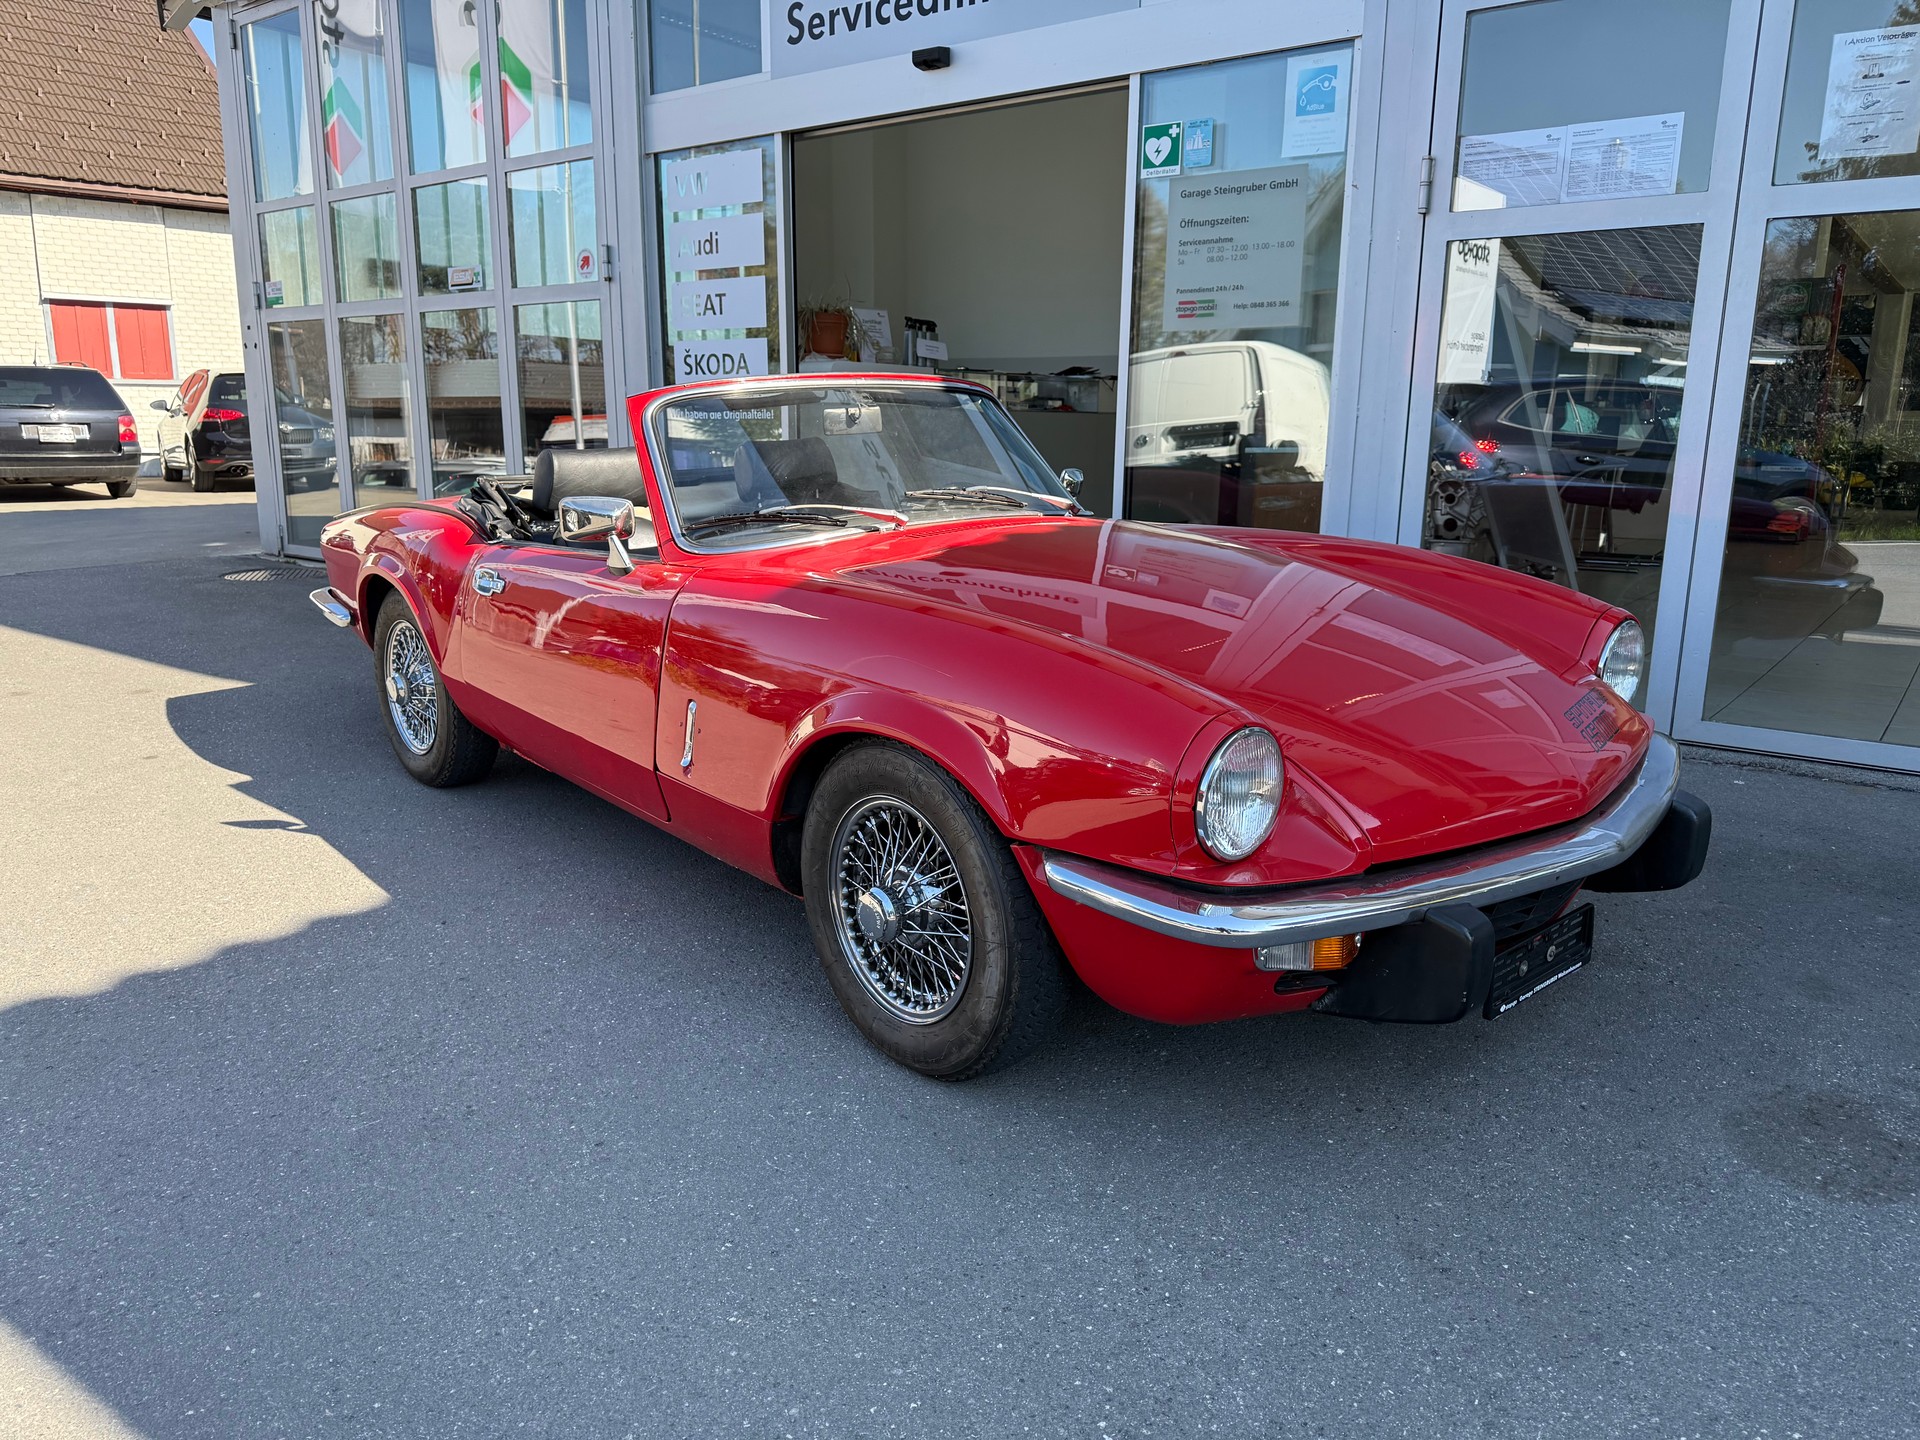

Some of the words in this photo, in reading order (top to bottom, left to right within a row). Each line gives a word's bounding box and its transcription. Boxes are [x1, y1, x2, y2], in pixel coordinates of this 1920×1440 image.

[787, 0, 990, 45] Servicea
[1848, 36, 1875, 46] Aktion
[1146, 168, 1177, 176] Defibrillator
[675, 171, 708, 198] VW
[1180, 187, 1211, 199] Garage
[1214, 182, 1267, 195] Steingruber
[1269, 178, 1299, 190] GmbH
[1180, 215, 1249, 228] Öffnungszeiten:
[678, 231, 719, 257] Audi
[1178, 236, 1233, 247] Serviceannahme
[1207, 245, 1225, 254] 07.30
[1231, 244, 1248, 252] 12.00
[1252, 242, 1270, 250] 13.00
[1277, 240, 1295, 248] 18.00
[1207, 255, 1224, 263] 08.00
[1230, 253, 1248, 261] 12.00
[1176, 286, 1214, 294] Pannendienst
[1233, 302, 1249, 310] Help:
[683, 348, 750, 375] ŠKODA
[685, 408, 708, 419] haben
[723, 408, 774, 421] Originalteile!
[1563, 687, 1608, 729] SPITFI
